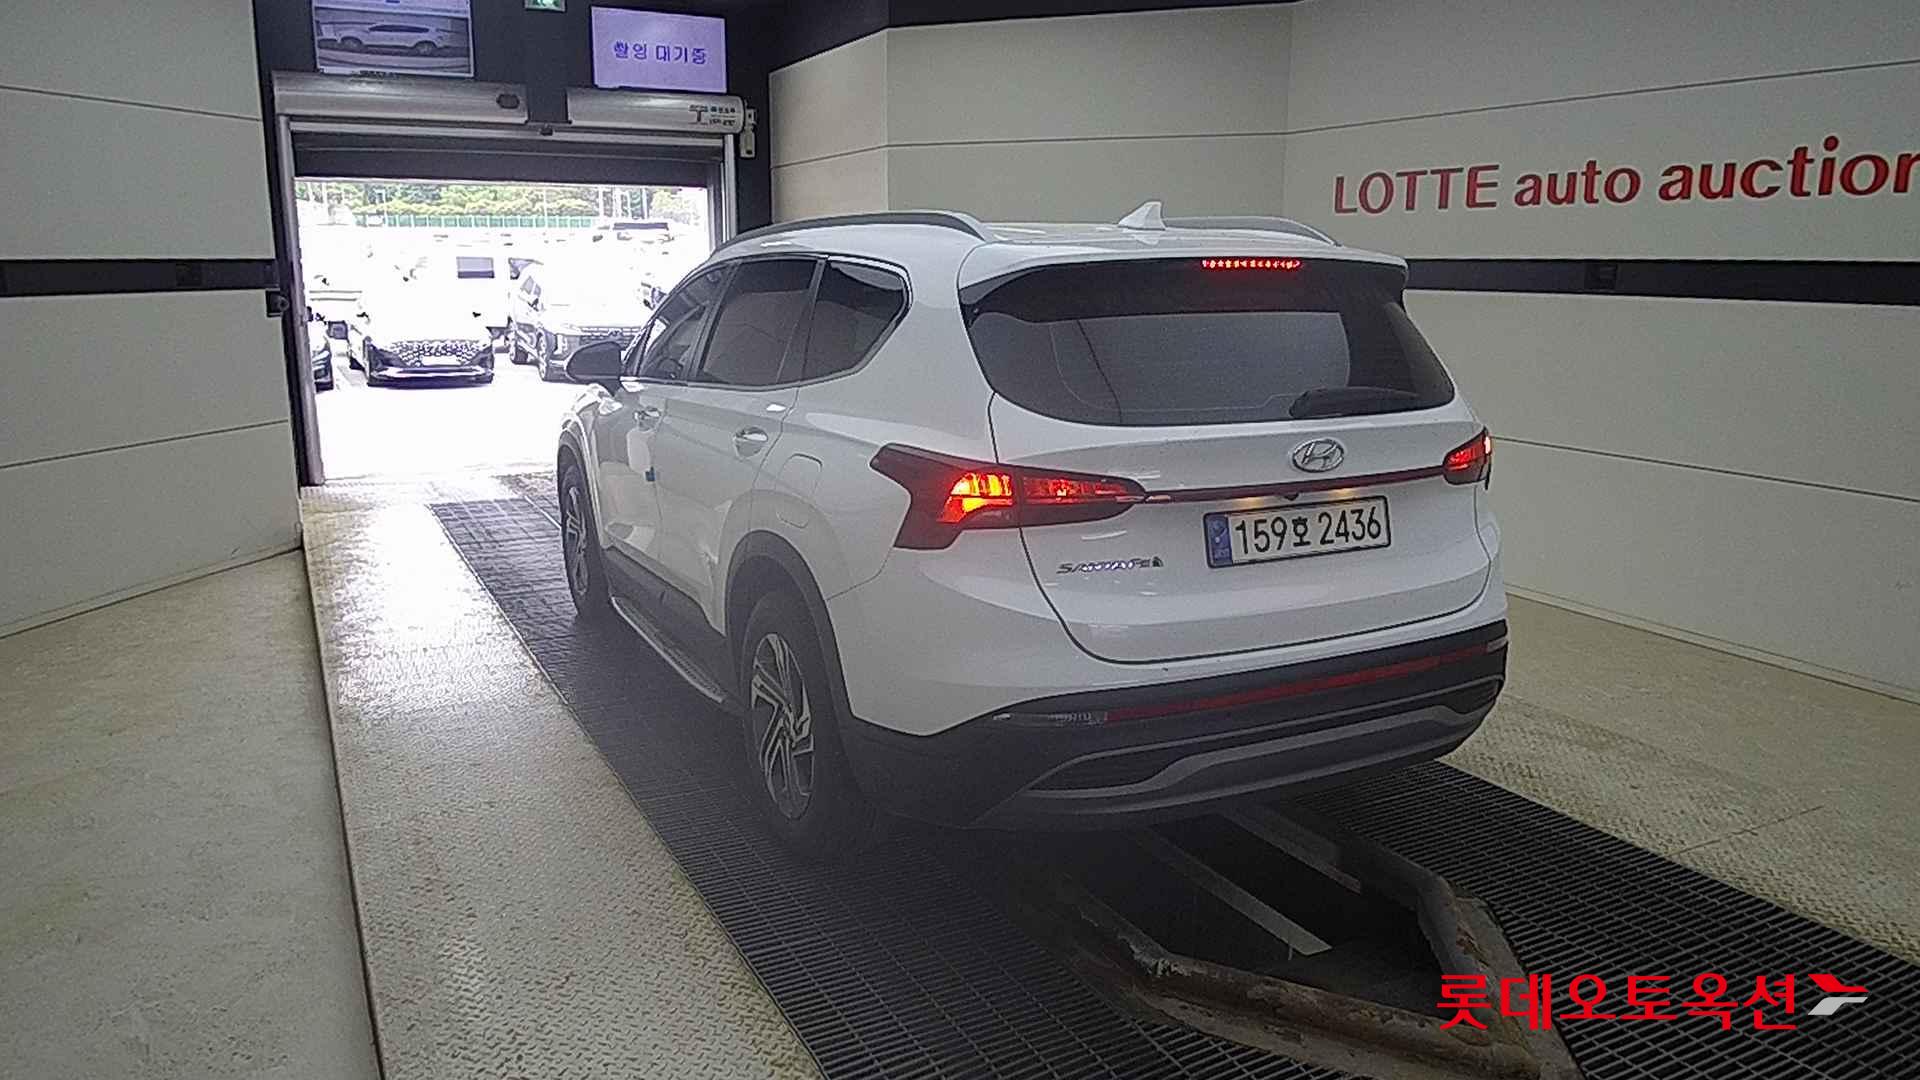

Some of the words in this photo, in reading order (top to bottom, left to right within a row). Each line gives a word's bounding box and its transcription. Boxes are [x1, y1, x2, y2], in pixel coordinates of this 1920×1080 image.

[1334, 164, 1500, 214] LOTTE
[1514, 160, 1641, 207] auto
[1235, 515, 1311, 554] 159호
[1317, 506, 1382, 546] 2436
